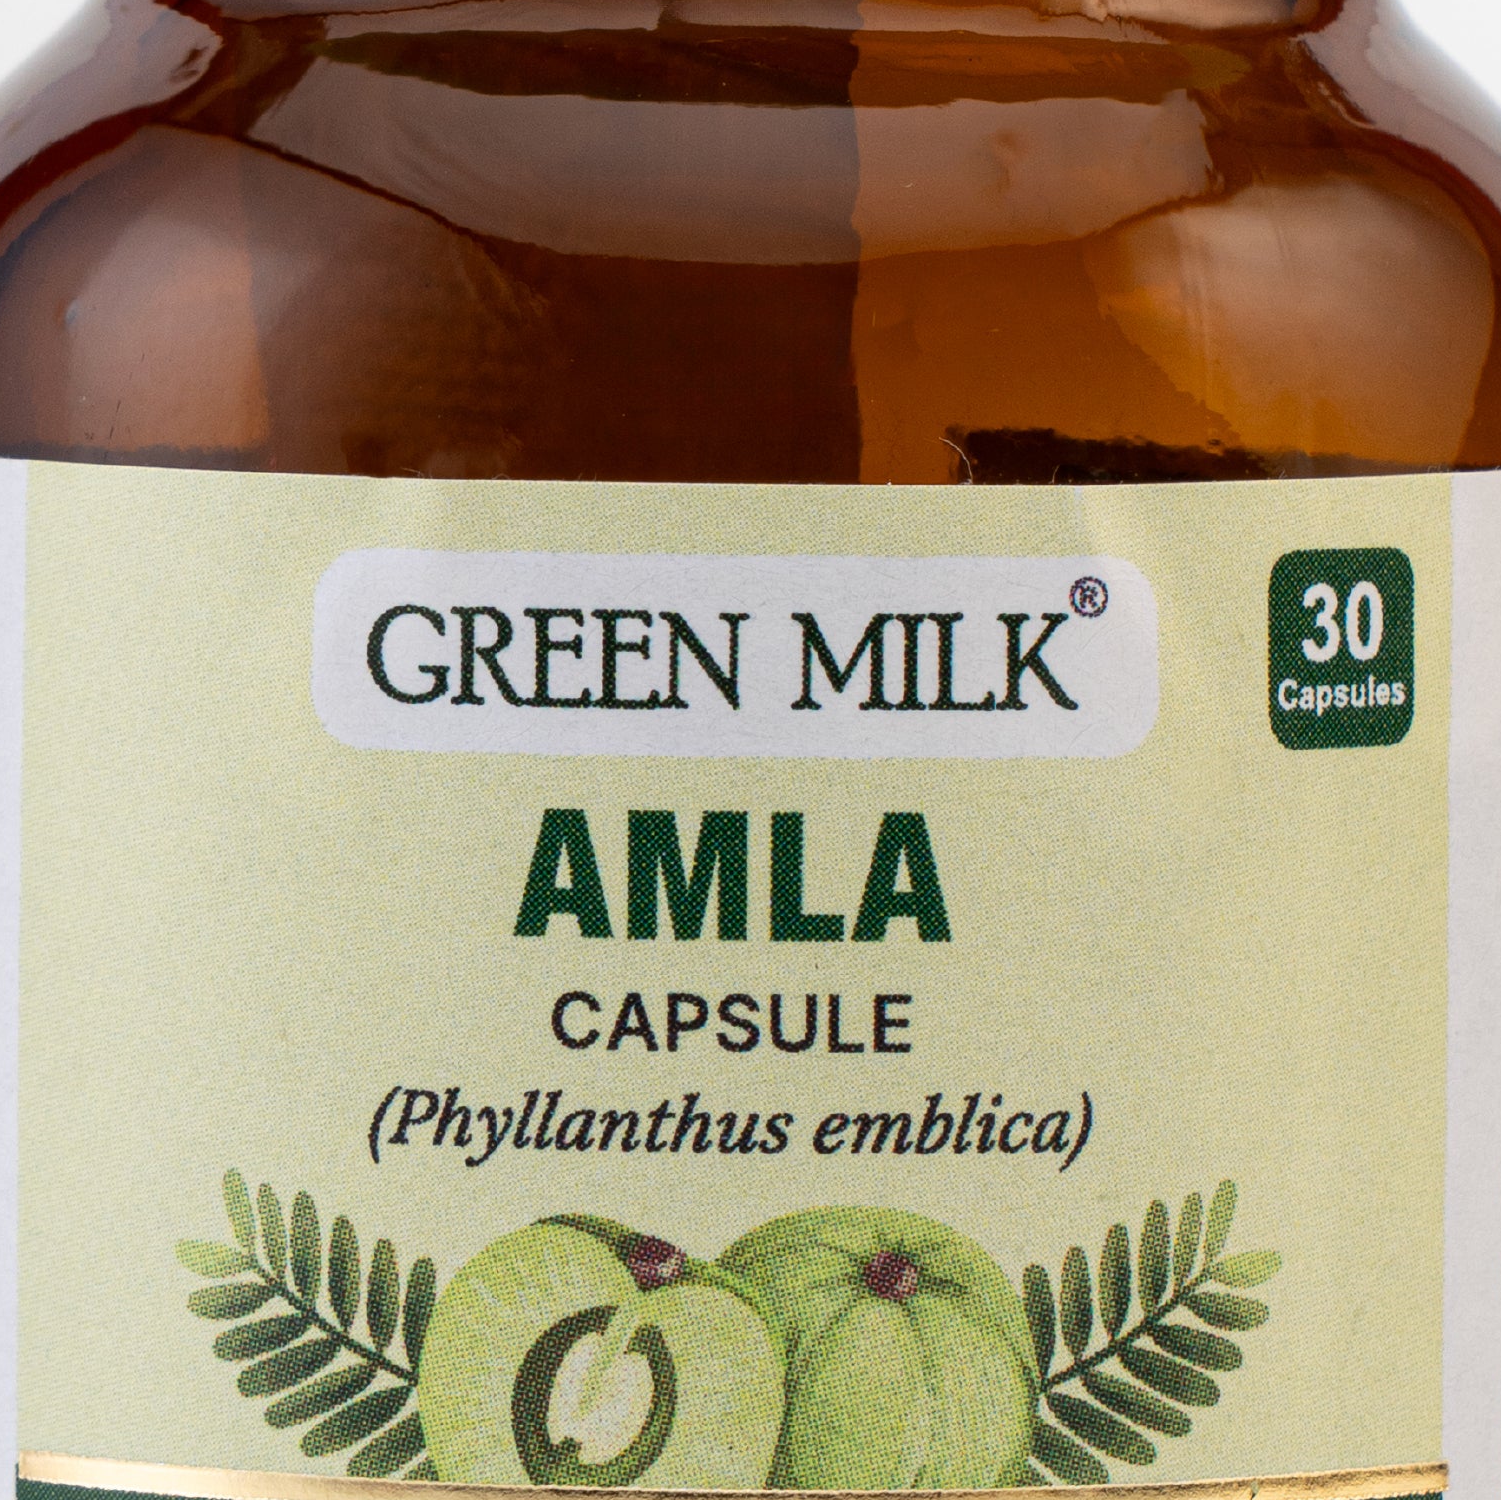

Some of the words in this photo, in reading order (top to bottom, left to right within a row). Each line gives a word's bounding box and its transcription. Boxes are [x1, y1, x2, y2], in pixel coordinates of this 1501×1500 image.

[367, 604, 752, 711] GREEN
[1301, 582, 1384, 664] 30
[1277, 674, 1406, 713] Capsules
[514, 809, 951, 942] AMLA
[551, 991, 913, 1053] CAPSULE
[368, 1086, 792, 1167] (Phyllanthus
[813, 1089, 1095, 1171] emblica)
